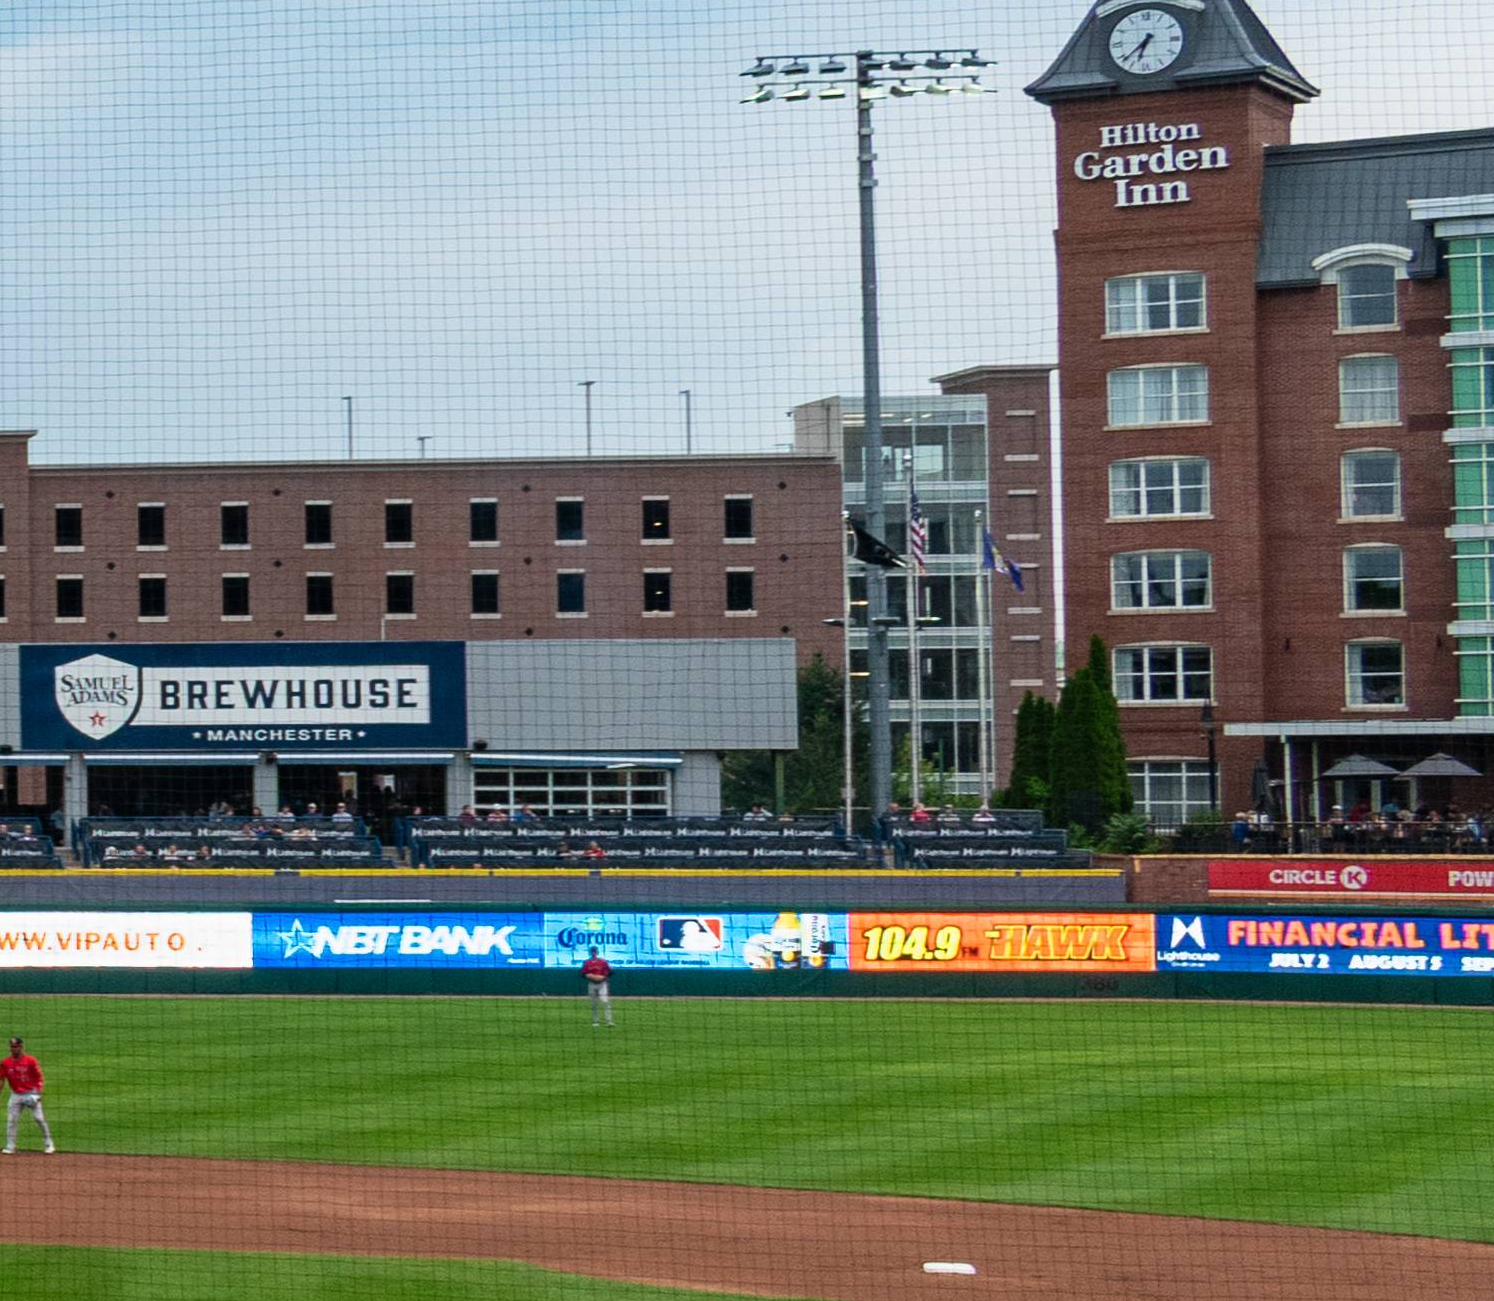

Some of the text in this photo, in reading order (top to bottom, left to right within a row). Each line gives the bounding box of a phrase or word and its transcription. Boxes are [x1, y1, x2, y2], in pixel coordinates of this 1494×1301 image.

[1099, 122, 1202, 148] Hilton
[1073, 143, 1231, 180] Garden
[1113, 179, 1191, 208] Inn
[61, 674, 134, 692] SAMUEL
[160, 677, 418, 710] BREWHOUSE
[66, 689, 128, 707] ADAMS
[206, 729, 354, 742] MANCHESTER
[1269, 869, 1336, 885] CIRCLE
[314, 925, 517, 957] NBT BANK
[557, 927, 628, 948] Corona
[863, 925, 962, 962] 104.9
[989, 925, 1131, 961] HAWK
[1228, 920, 1425, 949] FINANCIAL
[1157, 950, 1220, 962] Lighthouse
[1269, 952, 1316, 968] JULY
[1318, 953, 1330, 968] 2
[1349, 954, 1428, 970] AUGUST
